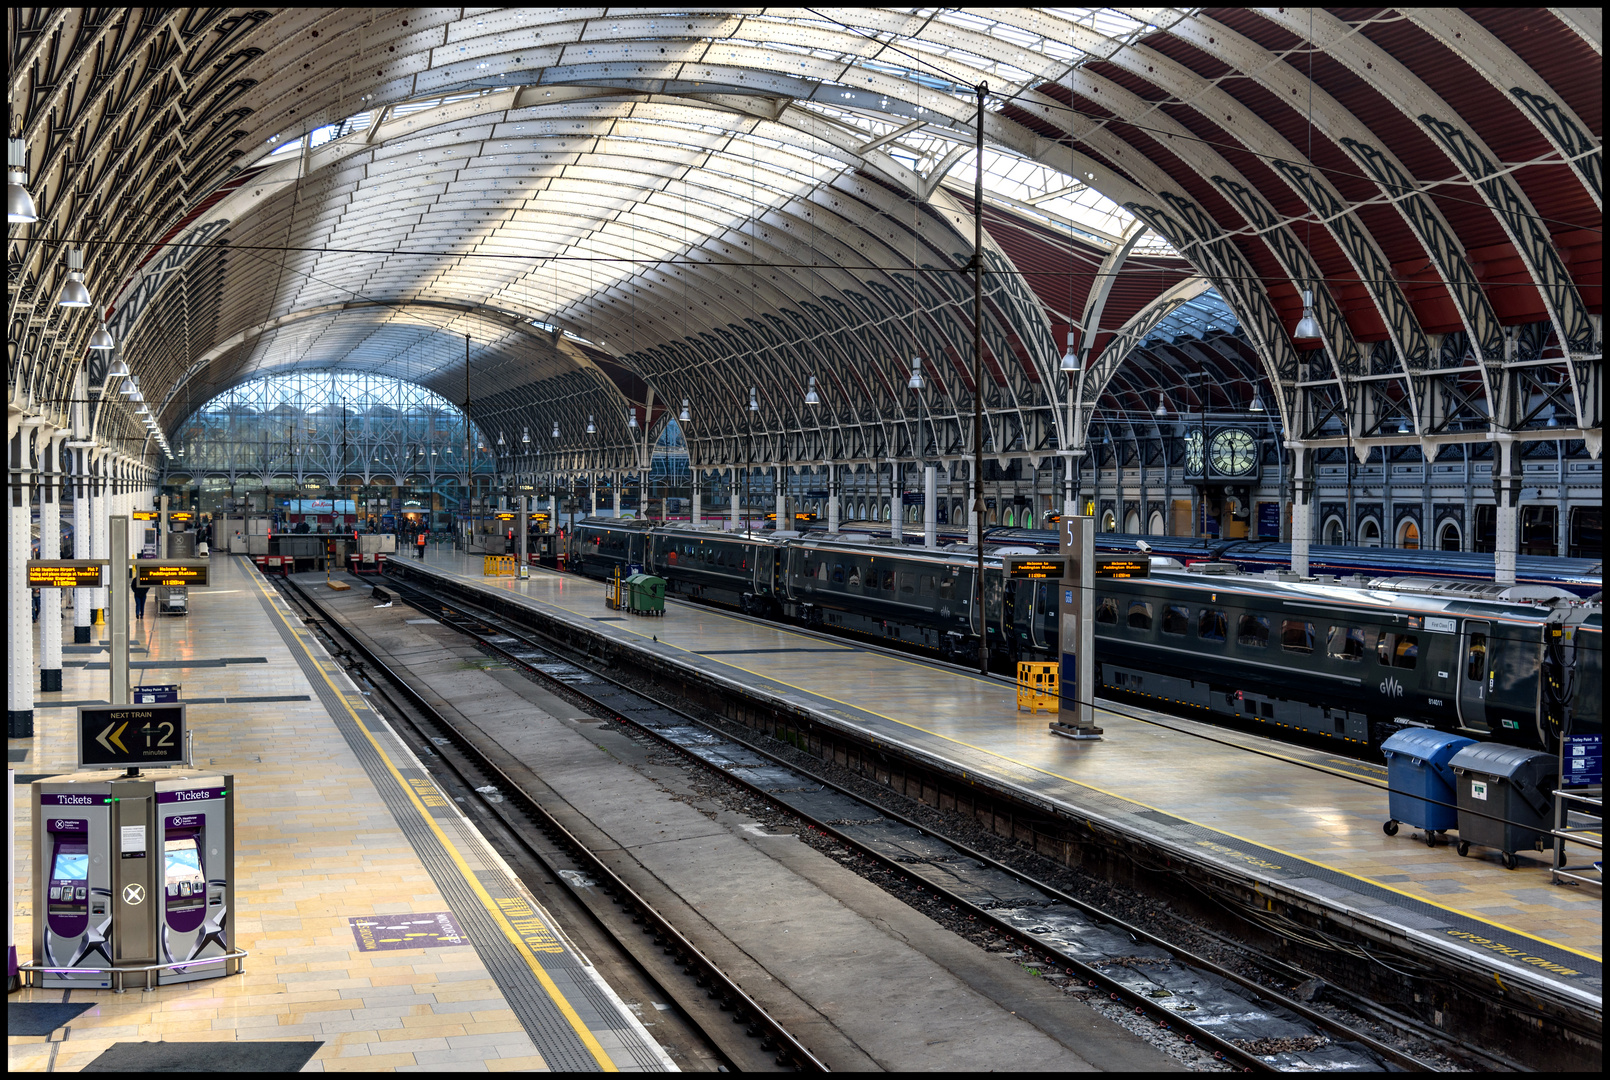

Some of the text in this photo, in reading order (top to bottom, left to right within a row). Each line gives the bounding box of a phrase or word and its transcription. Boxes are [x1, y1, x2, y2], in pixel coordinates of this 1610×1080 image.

[1066, 520, 1073, 546] 5
[1380, 676, 1403, 698] GWR
[1478, 686, 1483, 699] 1
[141, 721, 175, 747] 12
[57, 794, 92, 805] Tickets
[175, 790, 210, 801] Tickets
[494, 897, 565, 954] MIND THE GAP
